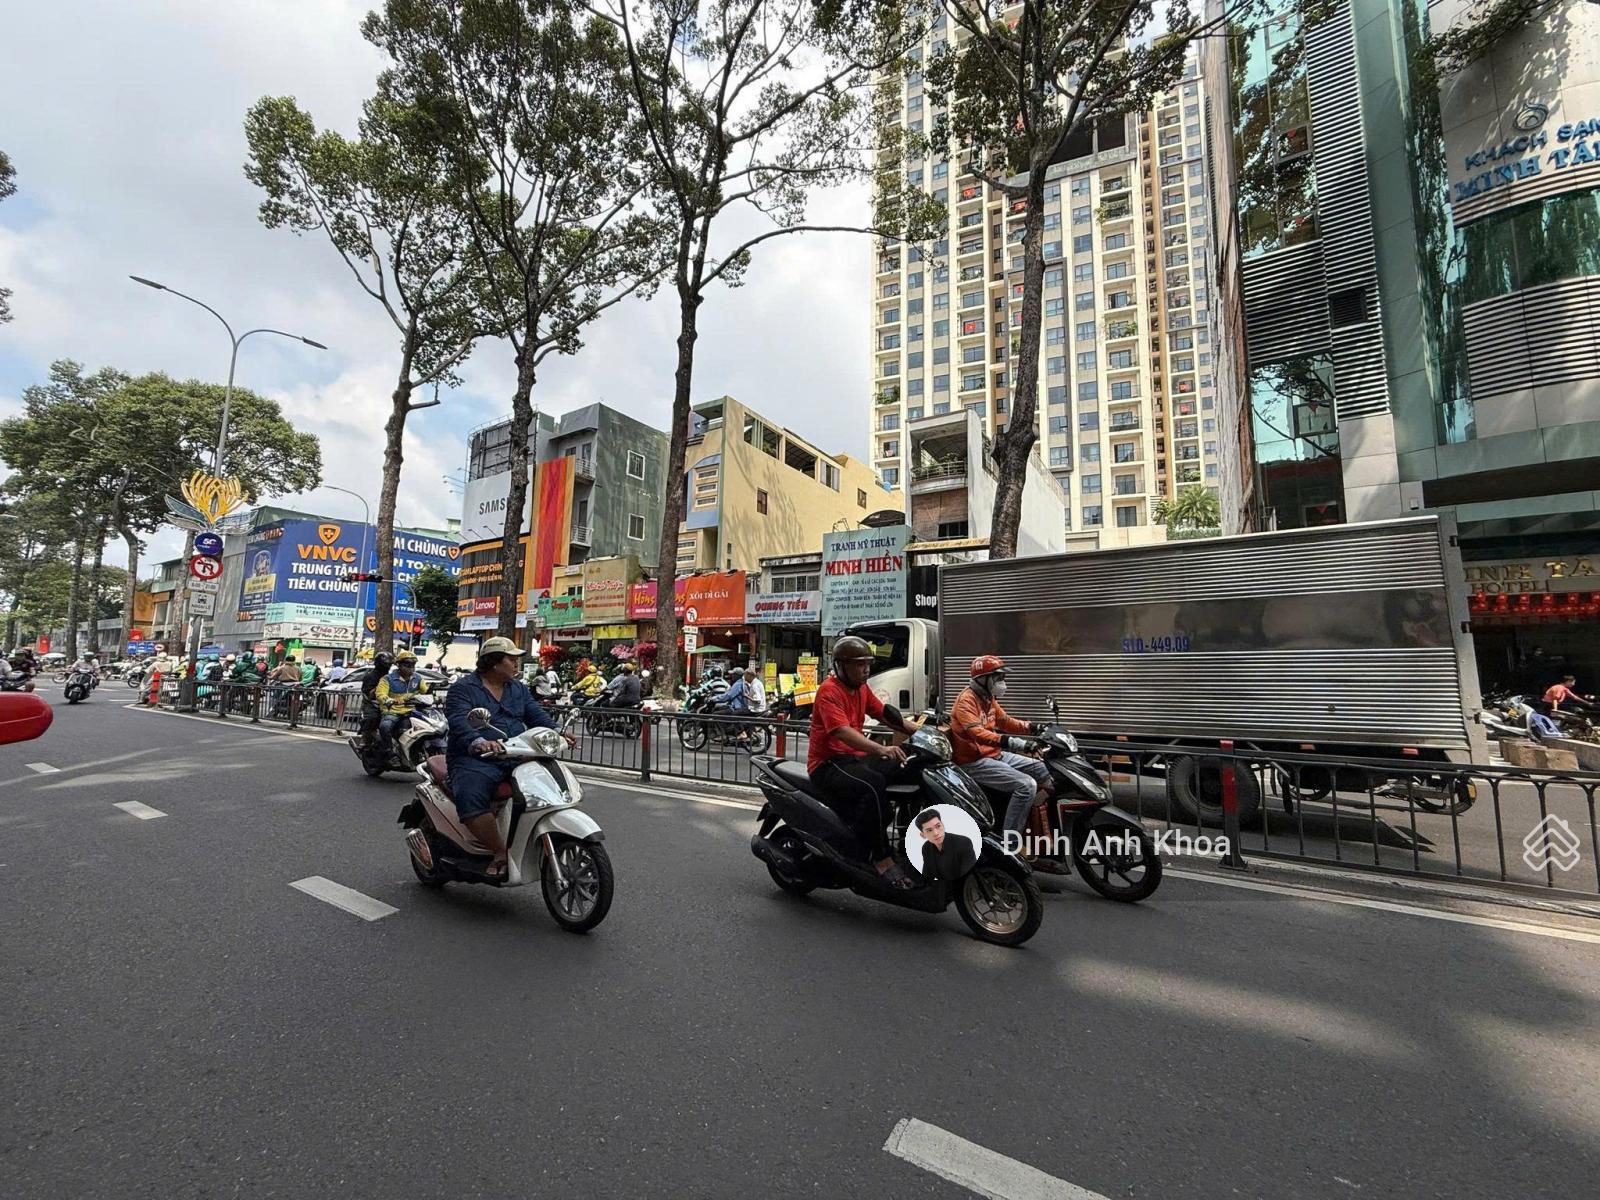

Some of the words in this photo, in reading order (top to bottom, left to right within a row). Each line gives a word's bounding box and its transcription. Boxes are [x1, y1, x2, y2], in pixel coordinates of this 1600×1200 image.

[1454, 155, 1542, 200] MINH
[831, 543, 856, 552] TRANH
[857, 538, 869, 550] MỸ
[871, 536, 897, 548] THUẬT
[297, 543, 357, 563] VNVC
[291, 562, 332, 576] TRUNG
[334, 564, 359, 578] TÂM
[825, 559, 862, 576] MINH
[865, 549, 903, 573] HIỀN
[1463, 563, 1532, 583] INH
[287, 577, 316, 590] TIÊM
[1471, 581, 1545, 594] HOTEL
[476, 600, 495, 609] Lenovo
[755, 601, 785, 611] QUANG
[787, 598, 808, 610] TIẾN
[915, 594, 937, 607] Shop
